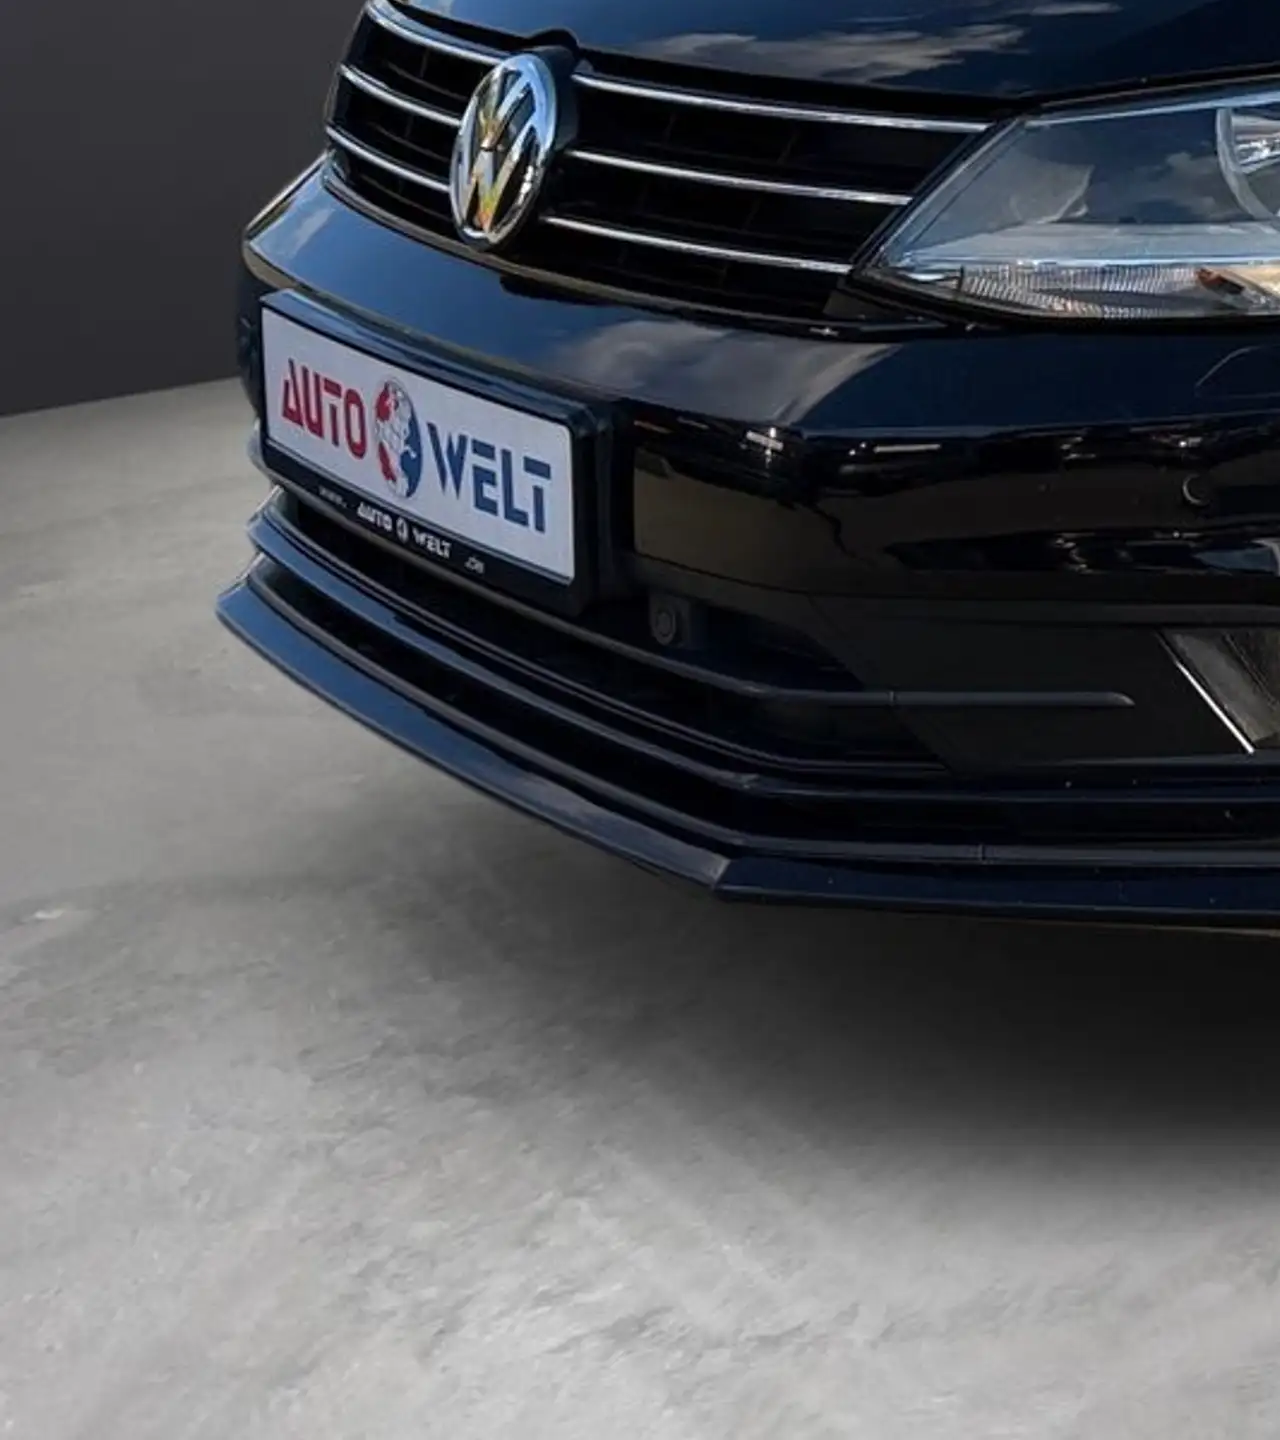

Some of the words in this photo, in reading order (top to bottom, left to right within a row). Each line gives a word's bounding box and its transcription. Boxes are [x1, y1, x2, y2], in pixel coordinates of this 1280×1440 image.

[282, 358, 368, 460] AUTO
[426, 421, 552, 534] WELT
[356, 501, 393, 533] AUTO
[413, 526, 452, 559] WELT
